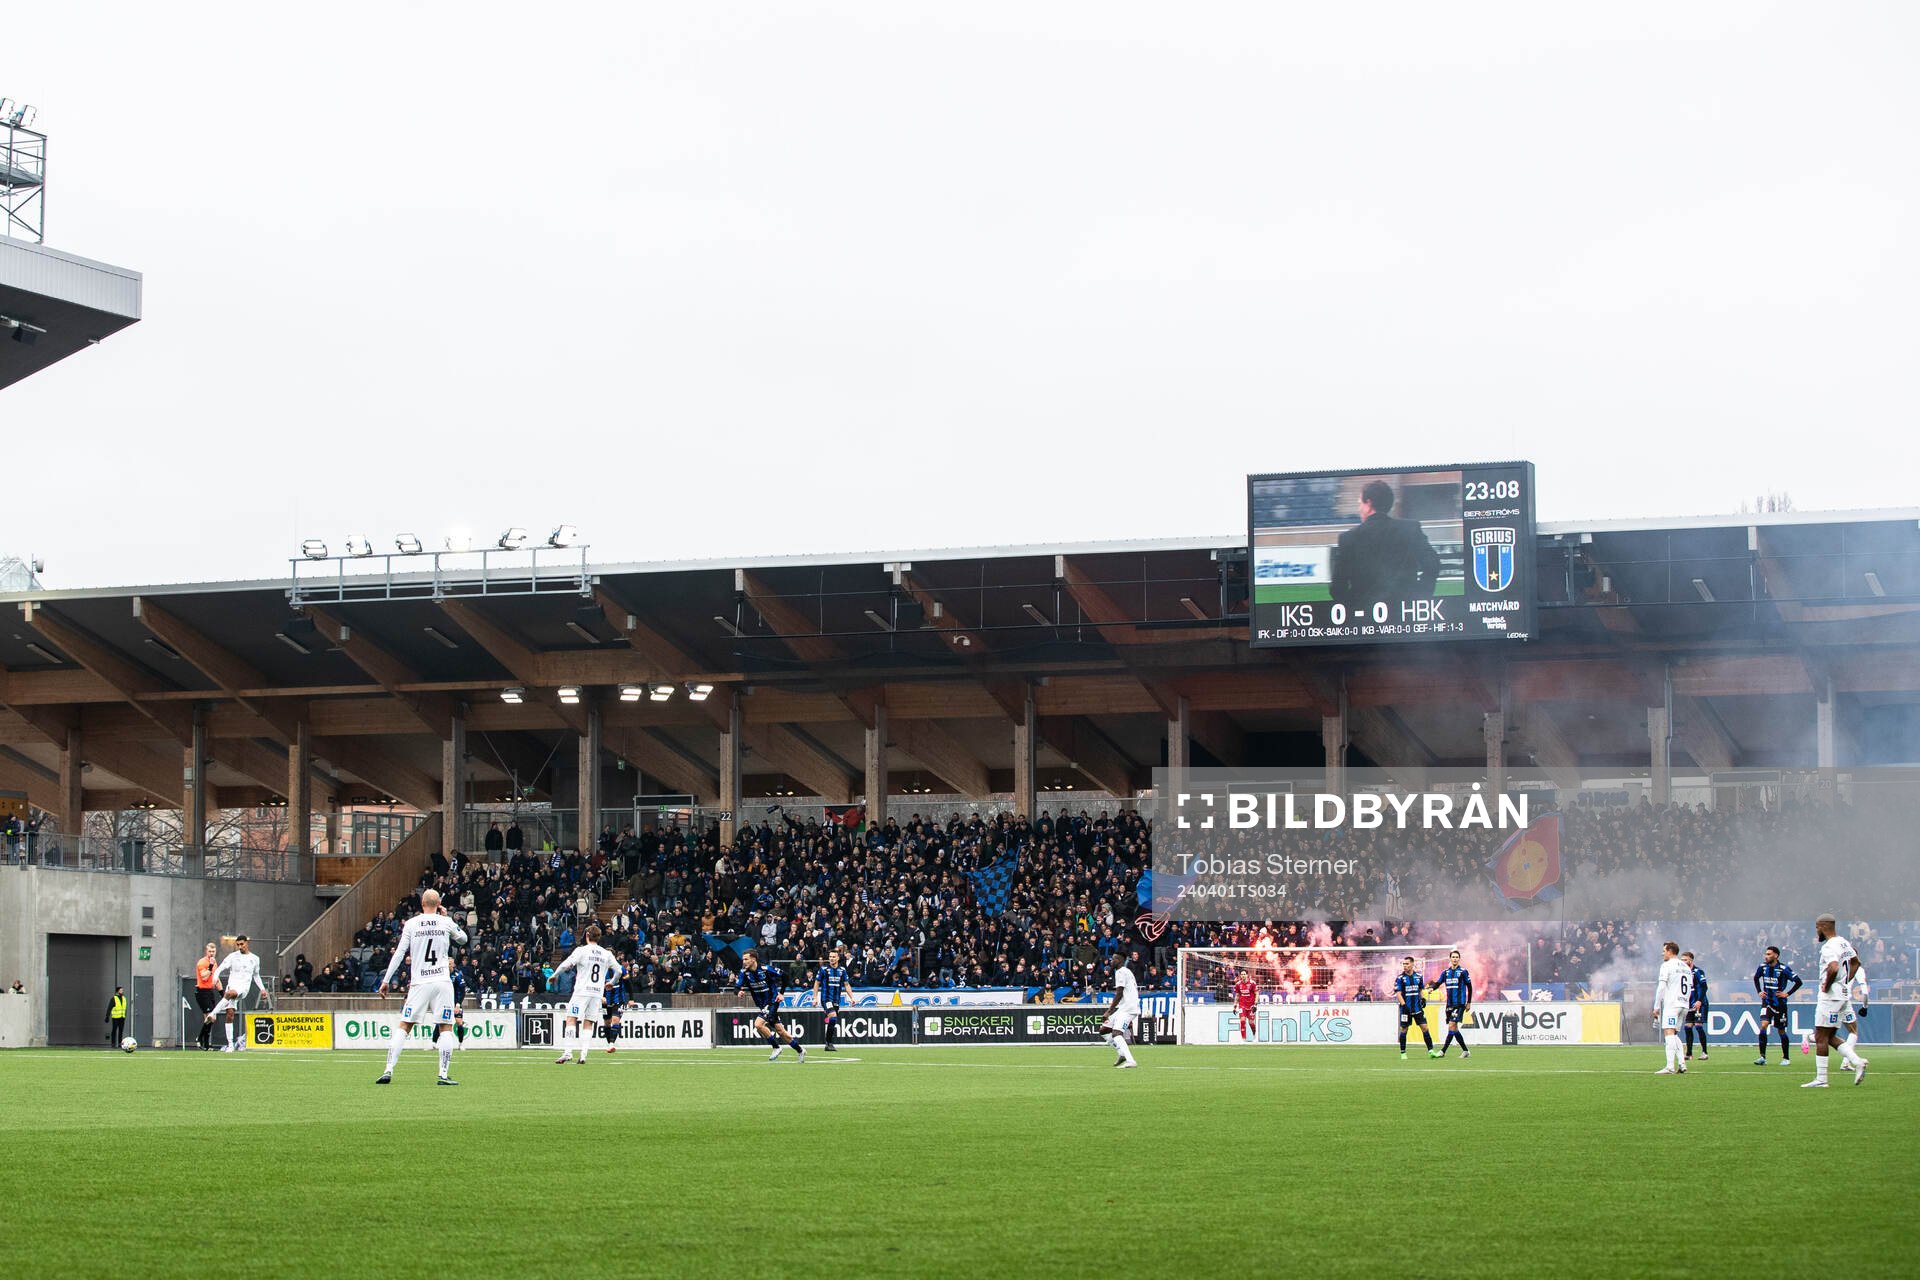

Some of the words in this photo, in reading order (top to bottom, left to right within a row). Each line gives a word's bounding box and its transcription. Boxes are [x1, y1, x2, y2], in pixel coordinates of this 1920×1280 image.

[1465, 480, 1520, 500] 23:08
[1475, 530, 1512, 544] SIRIUS
[1281, 604, 1313, 626] IKS
[1331, 603, 1346, 625] 0
[1372, 601, 1388, 623] 0
[1401, 600, 1445, 622] HBK
[1469, 600, 1520, 612] MATCHVÄRD
[1258, 629, 1270, 639] IFK
[720, 811, 732, 821] 22
[414, 930, 446, 938] JOHANSSON
[424, 938, 438, 966] 4
[590, 963, 600, 983] 8
[1680, 975, 1688, 996] 6
[1316, 1008, 1350, 1017] JÄRN
[1476, 1005, 1568, 1030] wber
[276, 1016, 325, 1024] SLANGSERVICE
[943, 1016, 1014, 1026] SNICKERI
[1046, 1014, 1104, 1026] SNICKE
[1218, 1010, 1353, 1043] Finks
[1707, 1010, 1814, 1036] DAL
[282, 1024, 312, 1032] UPPSALA
[345, 1020, 392, 1039] Olle
[592, 1020, 676, 1039] etilation
[681, 1019, 704, 1039] AB
[732, 1018, 805, 1039] inkb
[943, 1026, 1014, 1036] PORTALEN
[1046, 1025, 1100, 1035] PORTAL
